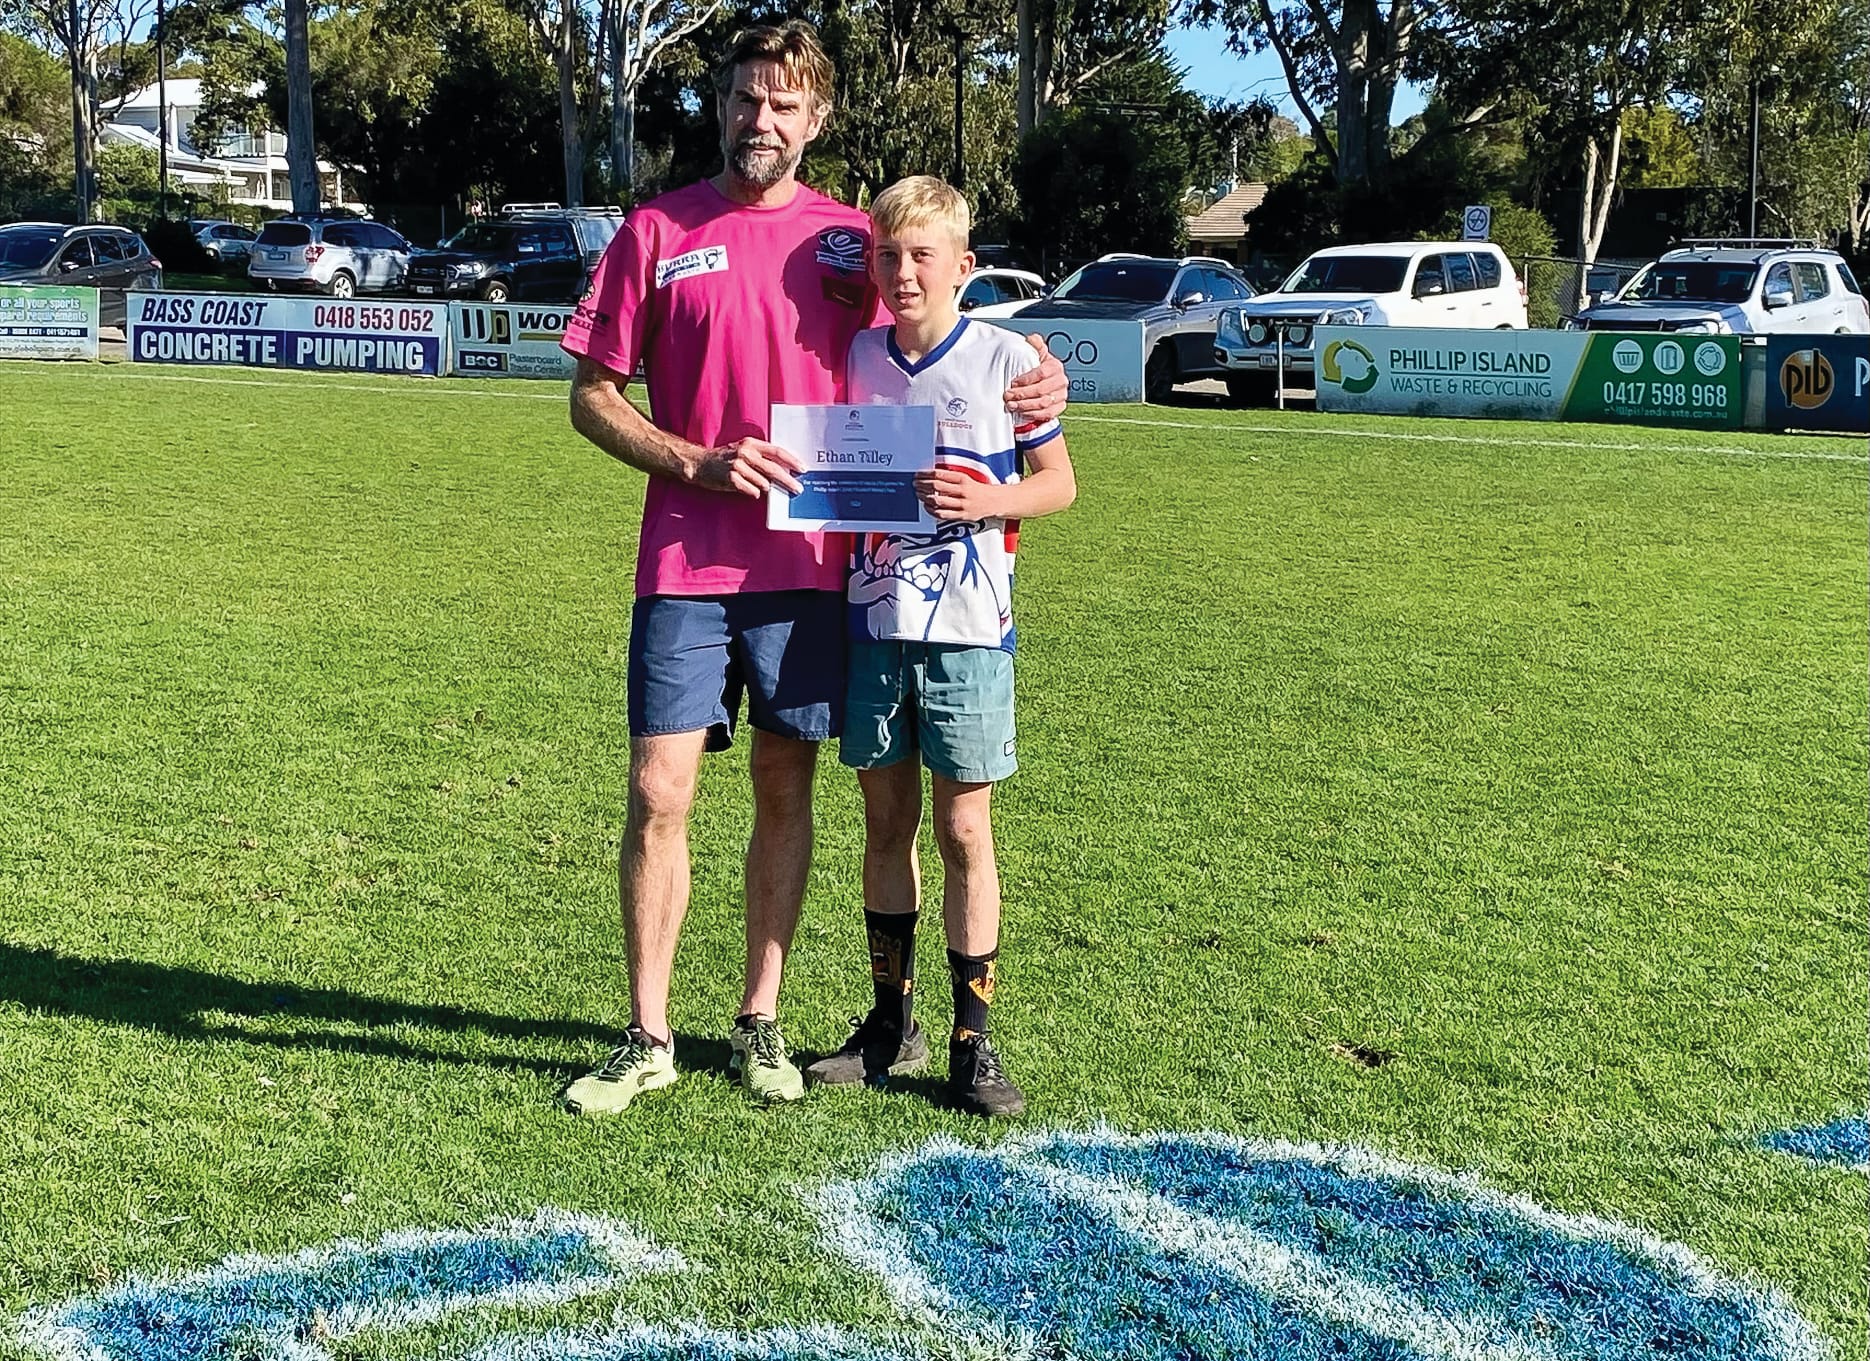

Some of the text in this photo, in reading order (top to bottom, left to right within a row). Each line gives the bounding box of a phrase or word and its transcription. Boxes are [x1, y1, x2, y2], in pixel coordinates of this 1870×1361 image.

[49, 299, 80, 310] sports
[141, 298, 268, 326] BASS COAST
[314, 305, 434, 332] 0418 553 052
[140, 330, 277, 363] CONCRETE
[296, 337, 424, 370] PUMPING
[1390, 349, 1551, 374] PHILLIP ISLAND
[1390, 377, 1552, 398] WASTE & RECYCLING
[1603, 381, 1727, 407] 0417 598 968
[817, 450, 893, 466] Ethan Tilley
